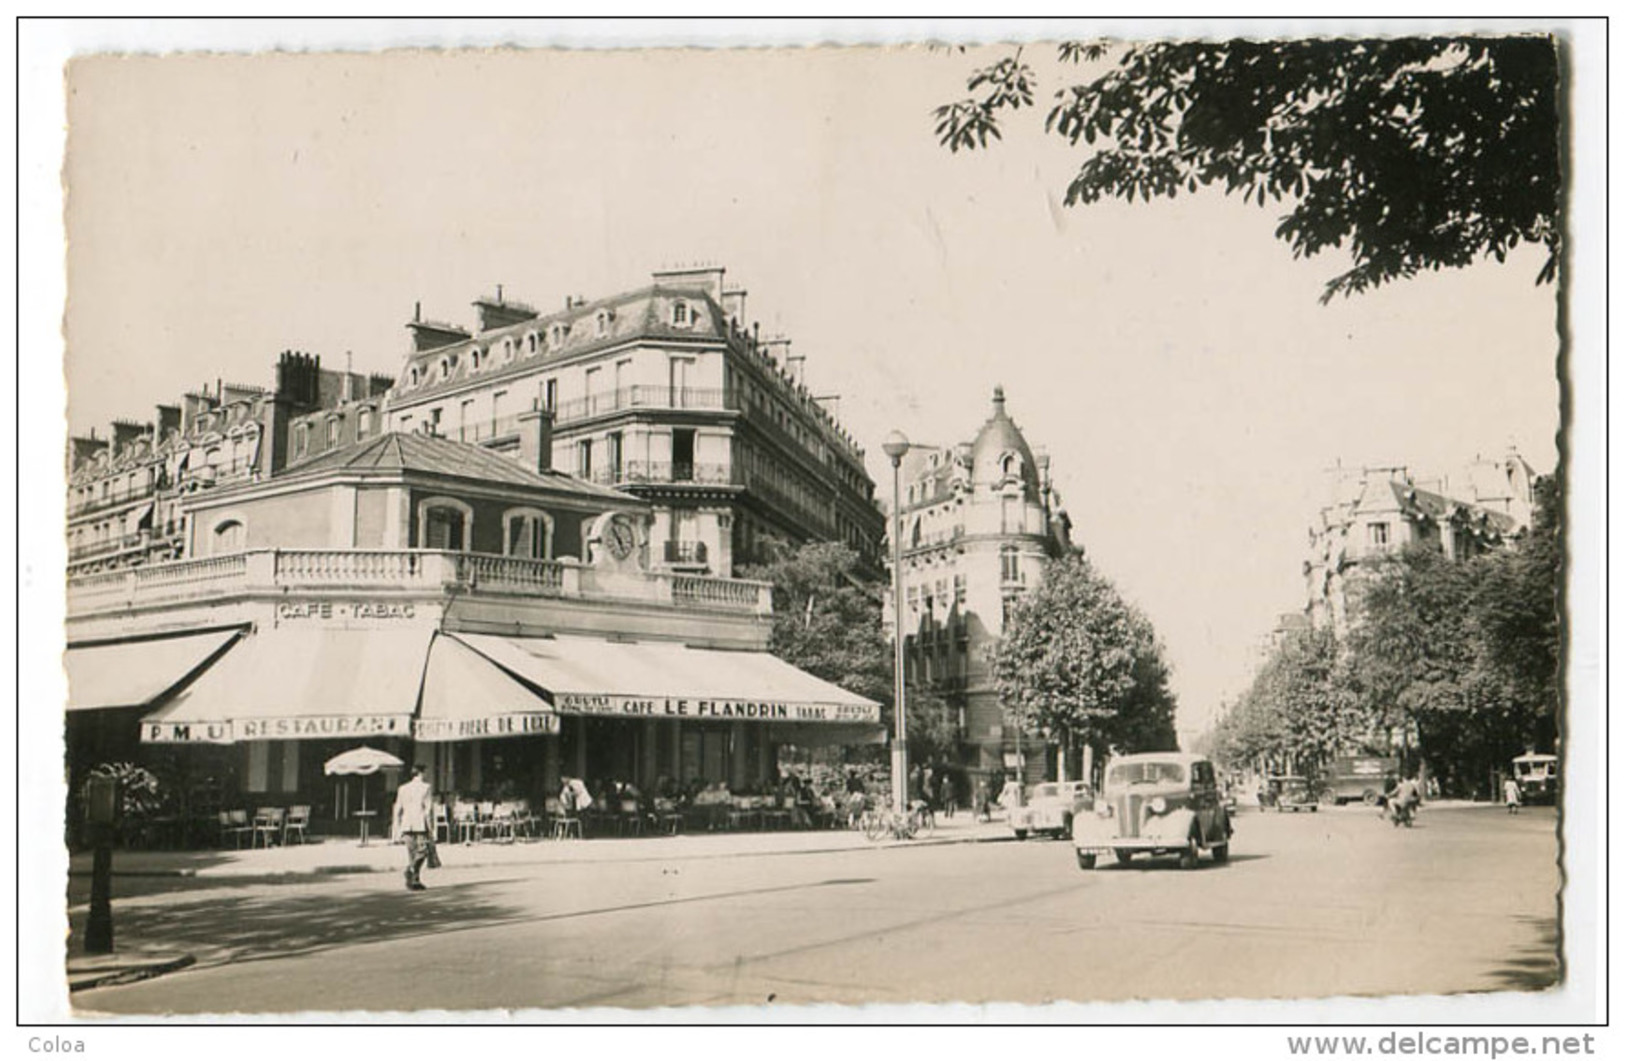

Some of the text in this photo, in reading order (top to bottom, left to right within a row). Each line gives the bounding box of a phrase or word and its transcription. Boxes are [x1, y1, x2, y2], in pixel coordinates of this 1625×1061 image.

[350, 603, 415, 619] TABAC
[665, 699, 688, 715] LE
[698, 701, 787, 717] FLANDRIN
[244, 717, 396, 736] RESTAURANT
